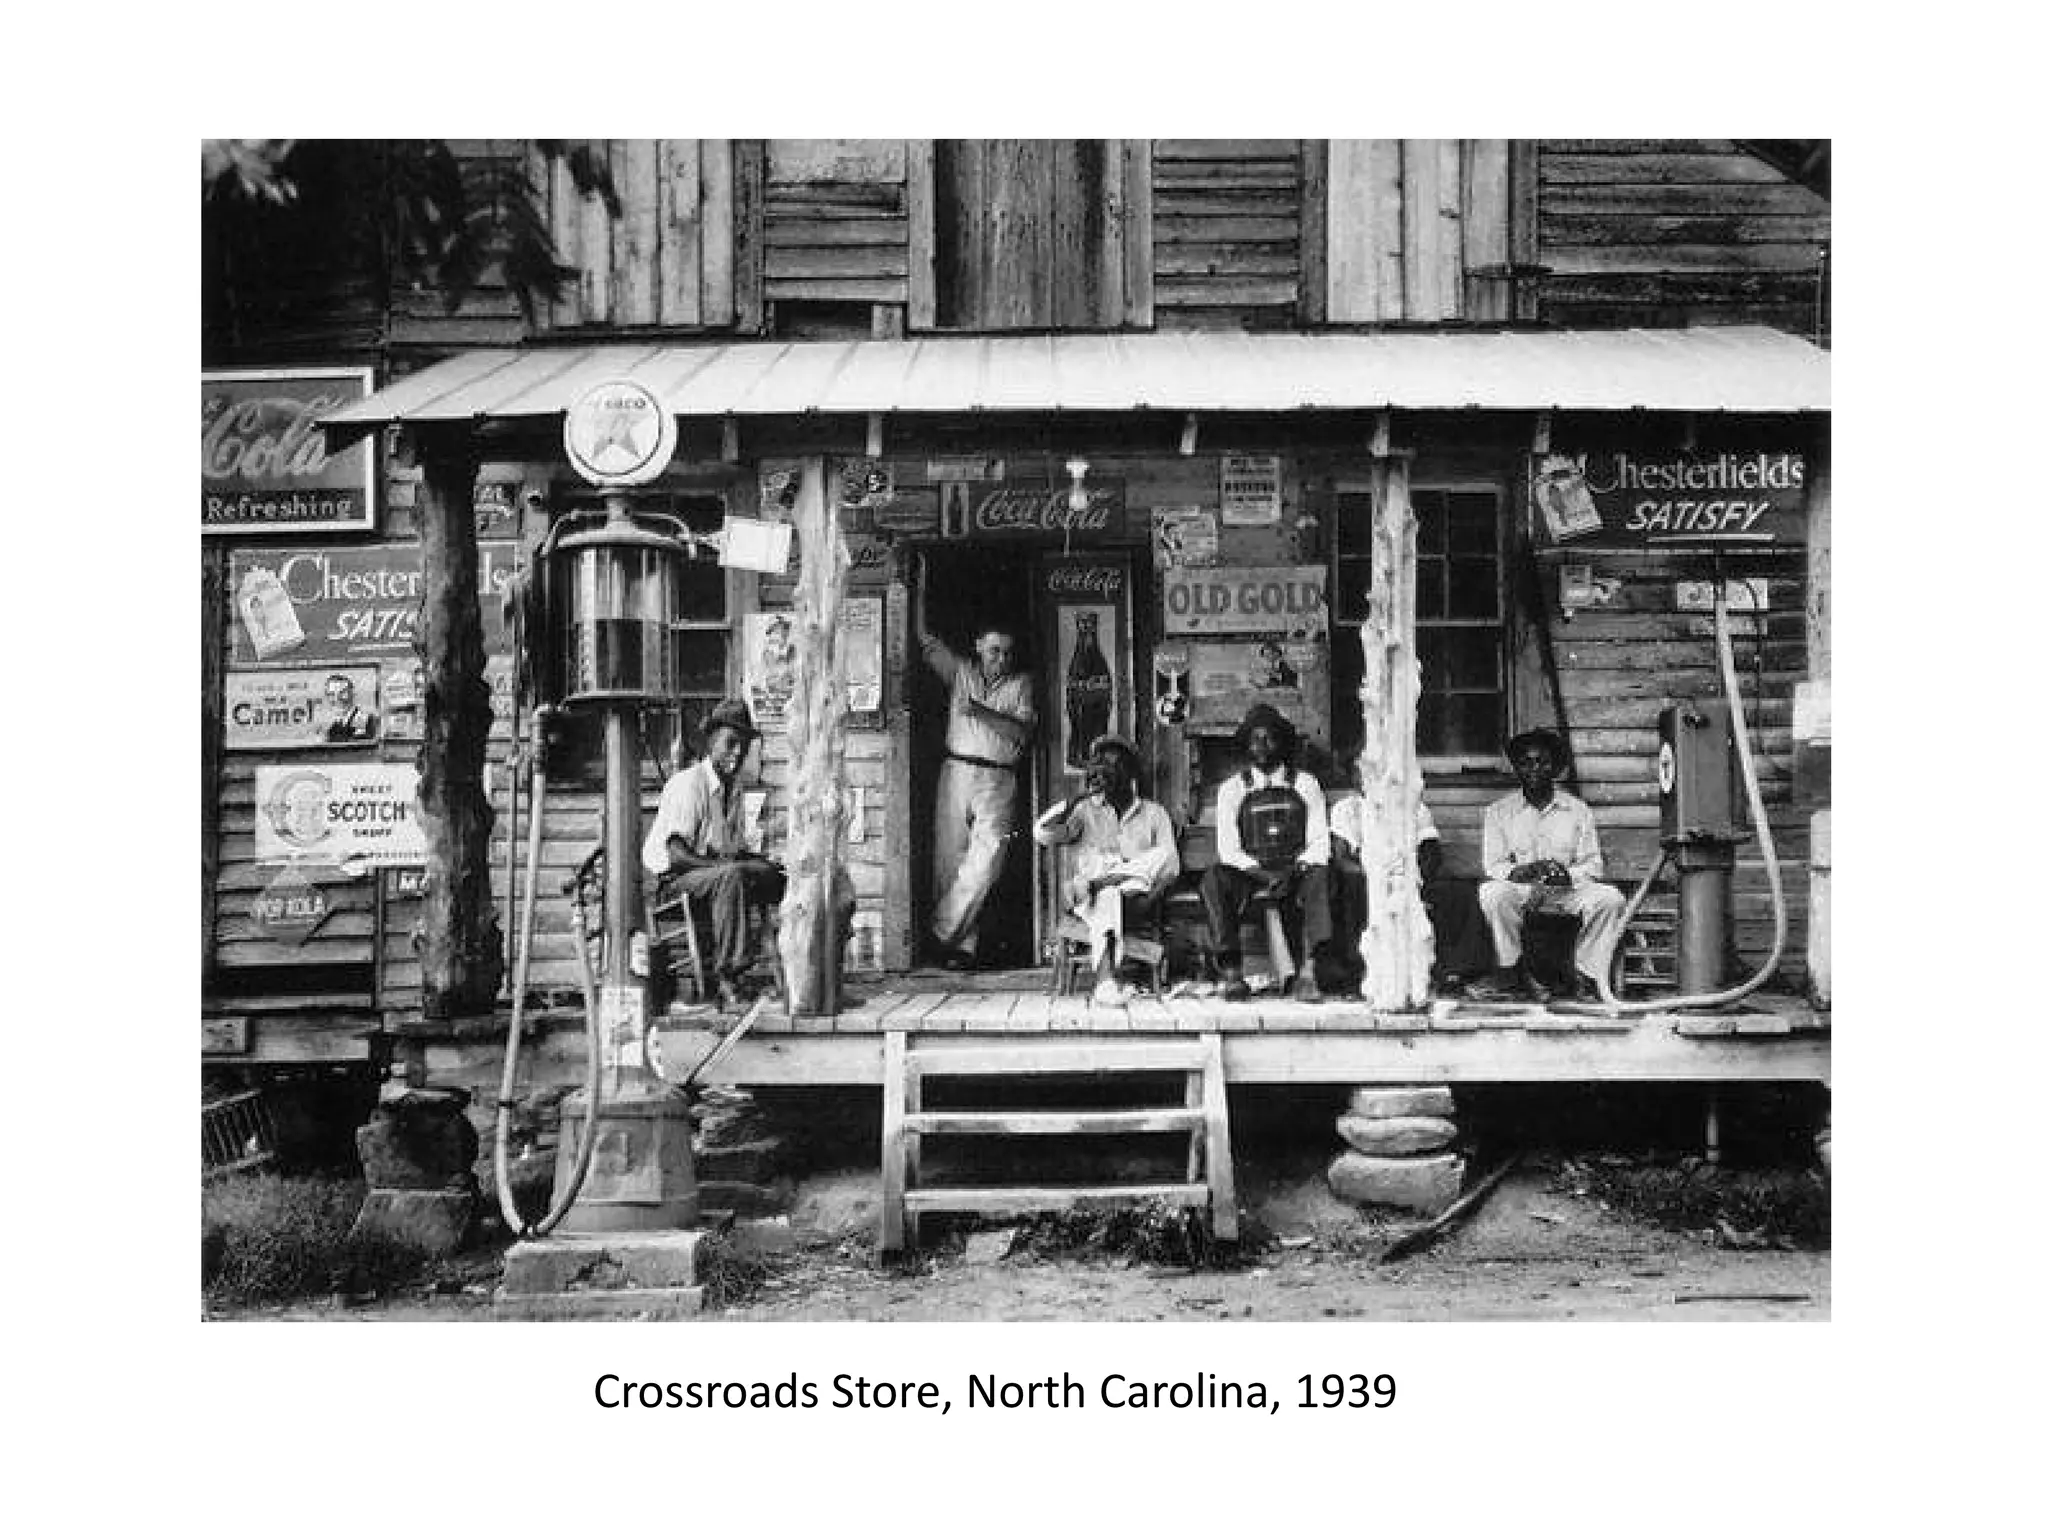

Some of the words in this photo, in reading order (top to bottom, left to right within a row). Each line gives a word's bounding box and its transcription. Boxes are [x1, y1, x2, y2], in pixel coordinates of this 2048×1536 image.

[207, 495, 352, 520] Refreshing
[1626, 500, 1770, 531] SATISFY
[1168, 582, 1231, 615] OLD
[1237, 582, 1322, 615] GOLD
[327, 801, 406, 823] SCOTCH
